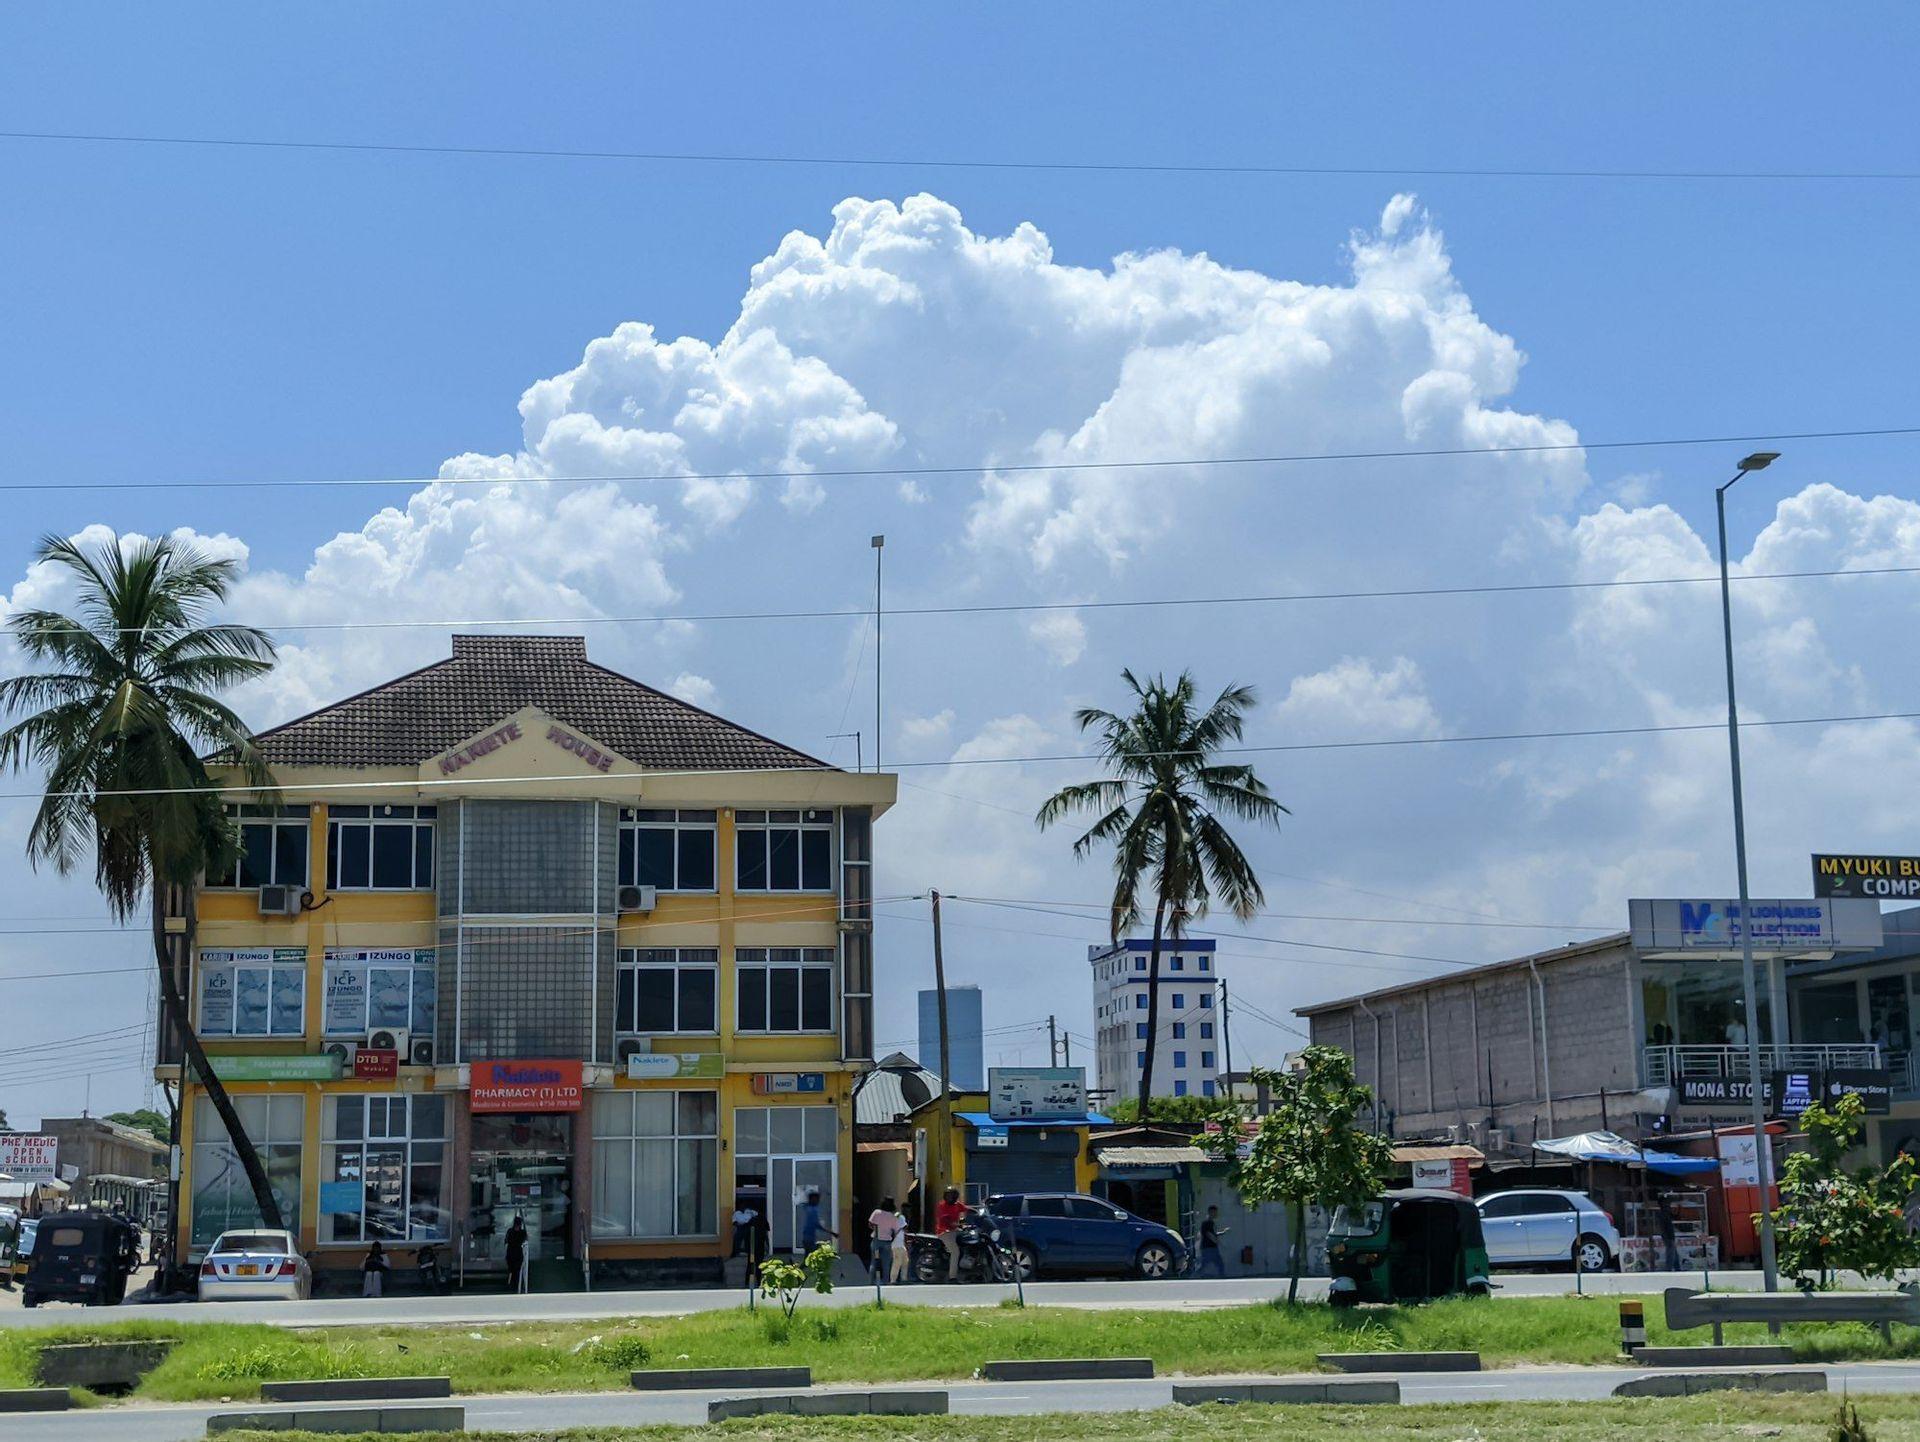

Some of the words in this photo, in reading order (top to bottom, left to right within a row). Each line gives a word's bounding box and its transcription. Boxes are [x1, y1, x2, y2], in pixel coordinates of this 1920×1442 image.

[546, 725, 614, 773] HOUSE
[1820, 858, 1892, 876] MYUKI
[1726, 906, 1822, 919] MILIONAIRES
[1728, 924, 1821, 937] CLLECTION
[369, 952, 411, 961] IZUNGO
[209, 979, 227, 988] ICP
[334, 976, 356, 985] ICP
[356, 1055, 379, 1065] DTB
[474, 1088, 537, 1098] PHARMACY
[540, 1087, 554, 1099] (T)
[557, 1087, 578, 1097] LTD
[1685, 1083, 1725, 1098] MONA
[1729, 1083, 1771, 1098] STOE
[1868, 1085, 1888, 1094] Store
[1, 1138, 21, 1147] PRE
[24, 1138, 56, 1147] MEDIC
[5, 1156, 49, 1164] SCHOOL
